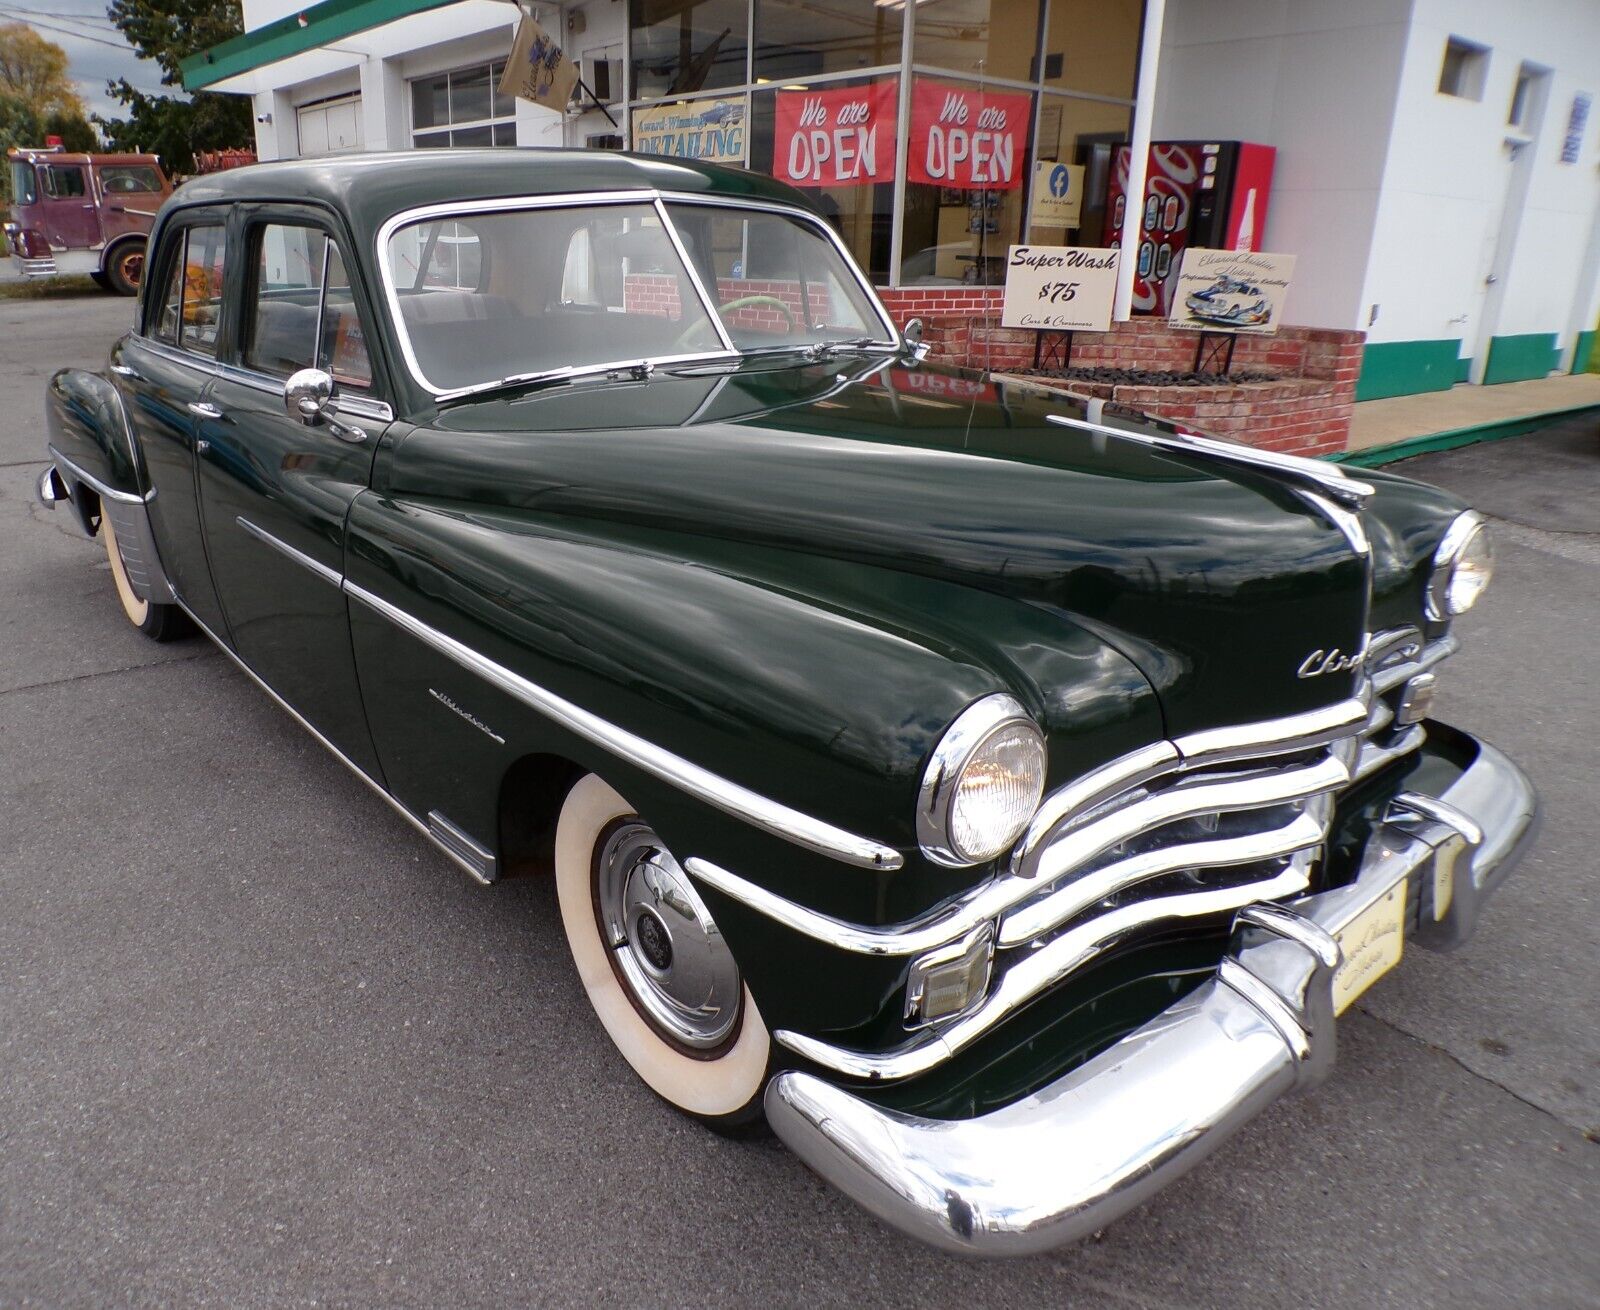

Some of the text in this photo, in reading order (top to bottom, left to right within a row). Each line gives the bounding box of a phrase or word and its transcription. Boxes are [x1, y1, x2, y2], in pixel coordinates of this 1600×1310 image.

[800, 96, 871, 128] We are
[940, 92, 1006, 131] We are
[638, 127, 743, 159] DETAILING
[787, 123, 877, 181] OPEN
[926, 124, 1013, 183] OPEN
[1010, 248, 1118, 271] Super Wash
[1038, 281, 1081, 304] $75
[1020, 313, 1041, 326] Cars
[1043, 316, 1051, 325] &
